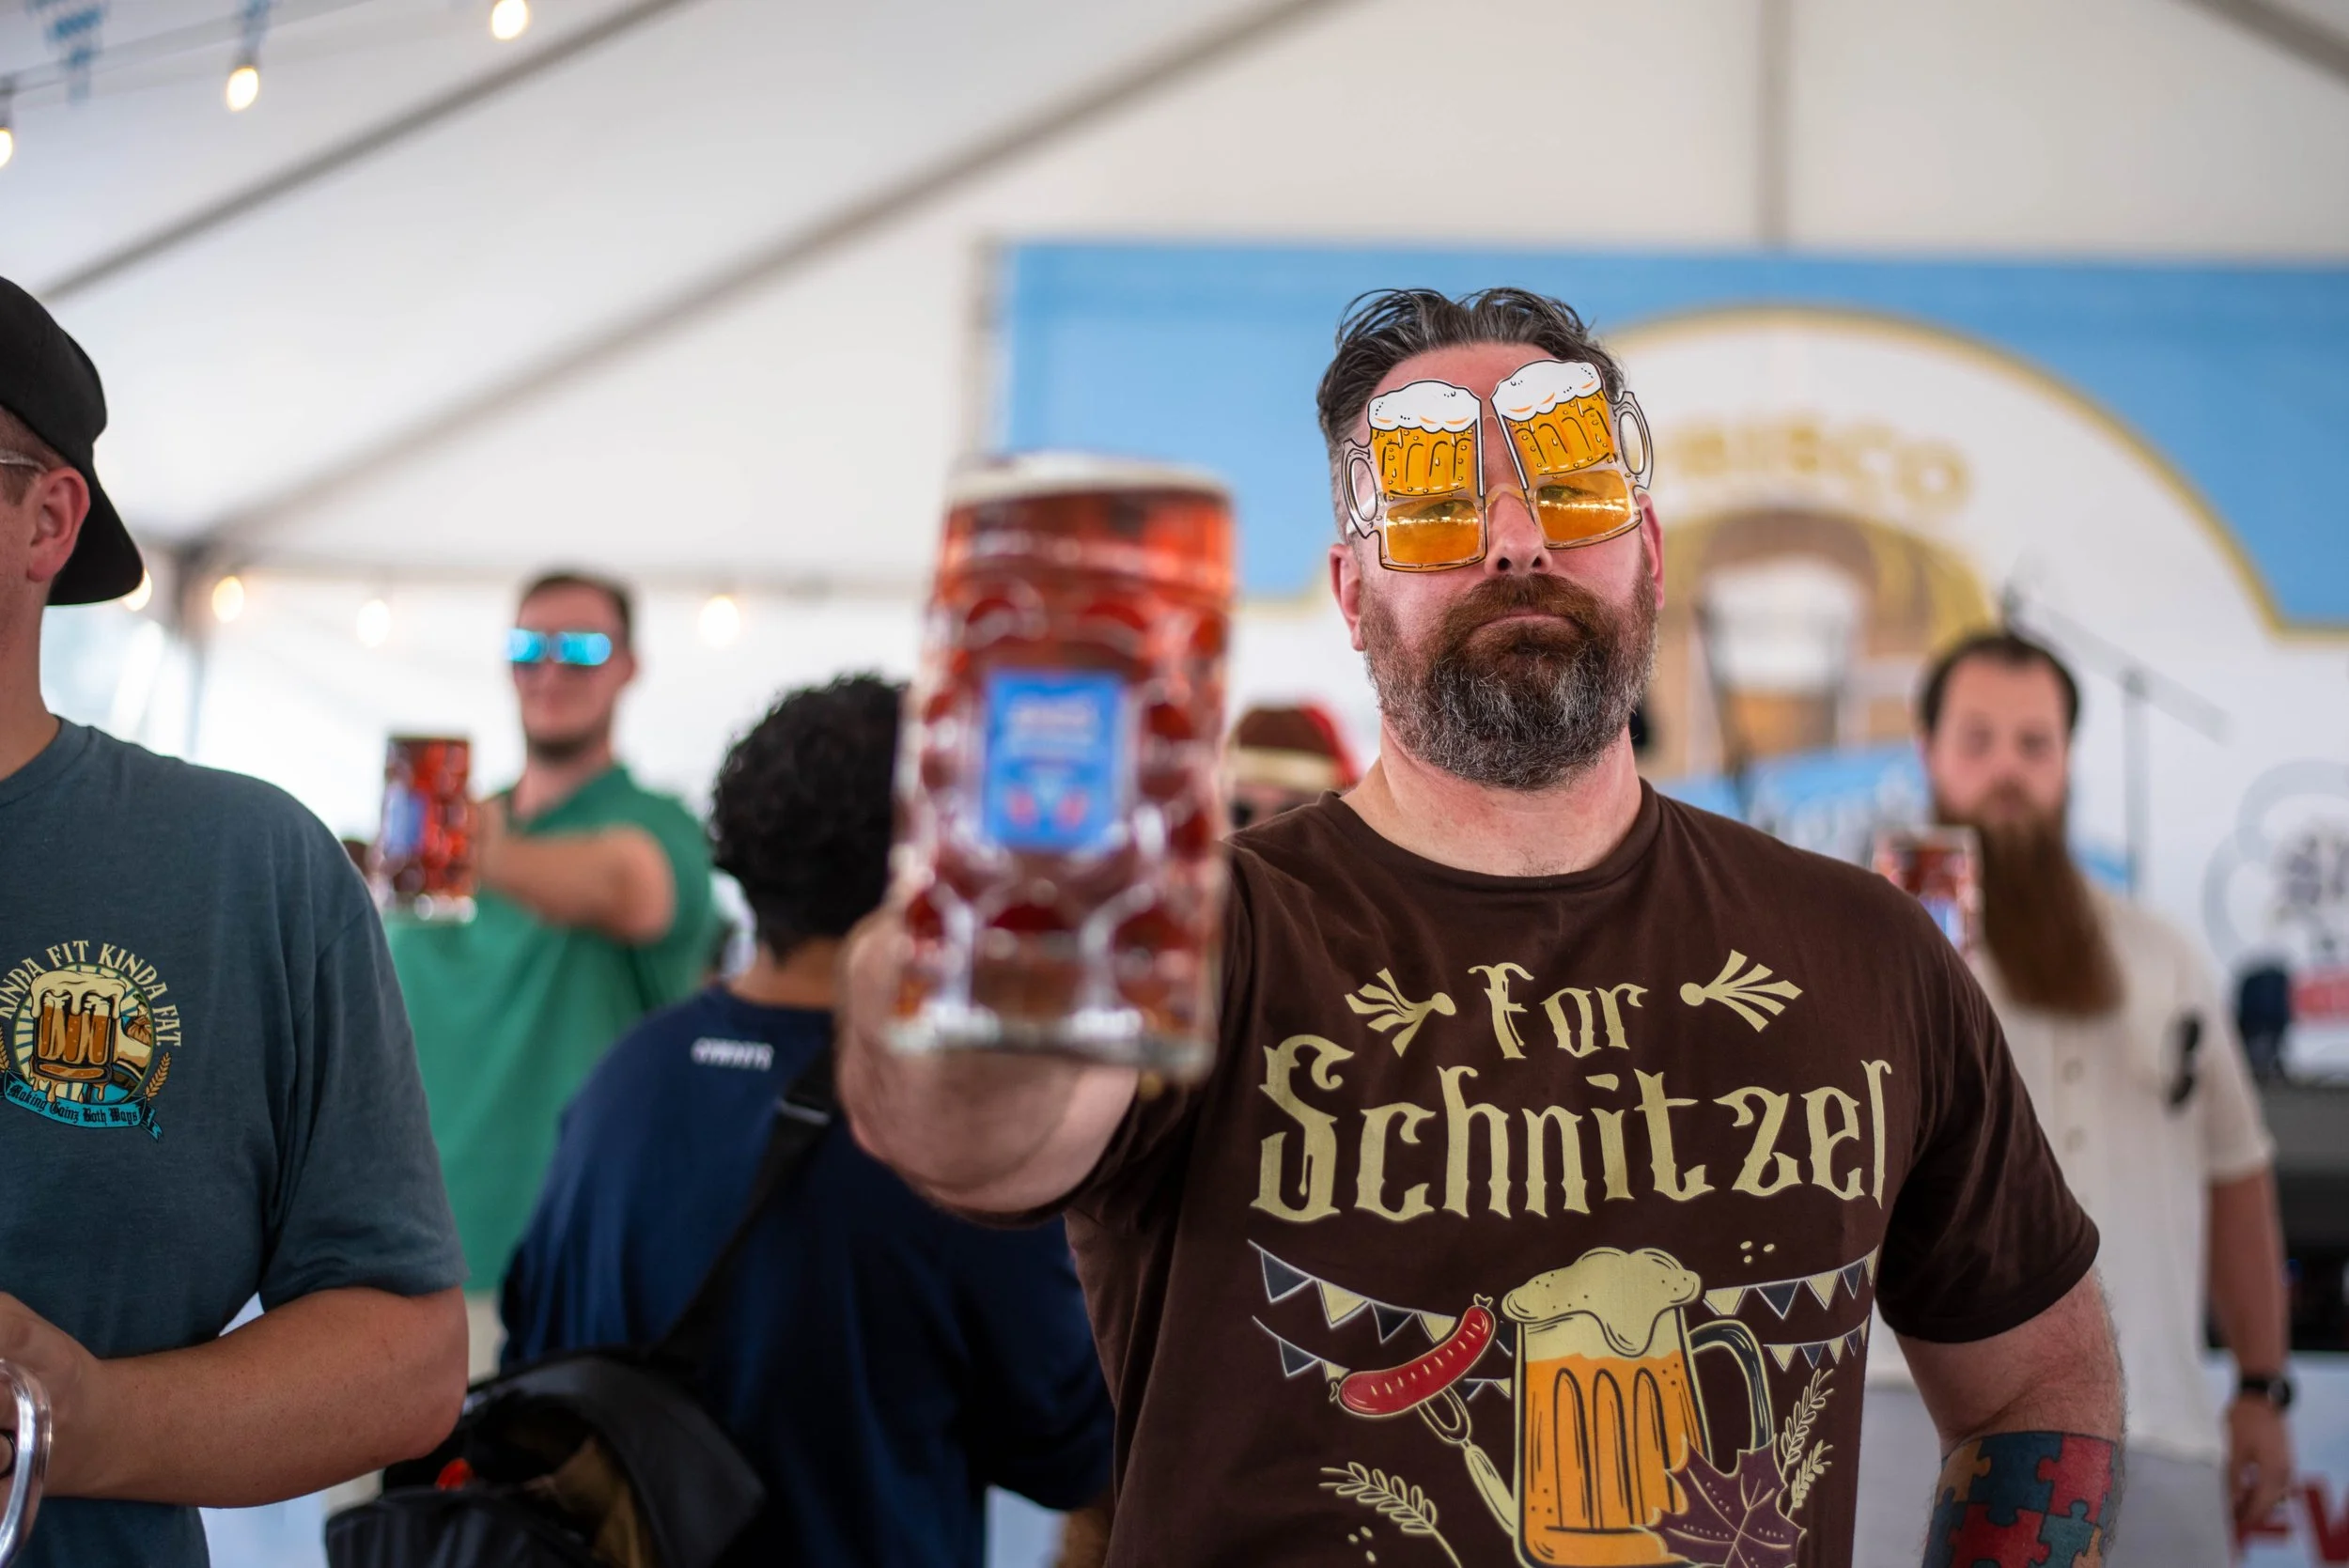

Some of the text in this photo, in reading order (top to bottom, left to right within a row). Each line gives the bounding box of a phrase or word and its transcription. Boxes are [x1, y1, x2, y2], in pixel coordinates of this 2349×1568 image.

[45, 939, 89, 969] FIT
[98, 942, 168, 1001] KINDA
[8, 1084, 138, 1126] Making Gainz Both Ways
[1250, 1034, 1891, 1222] Schnitzel
